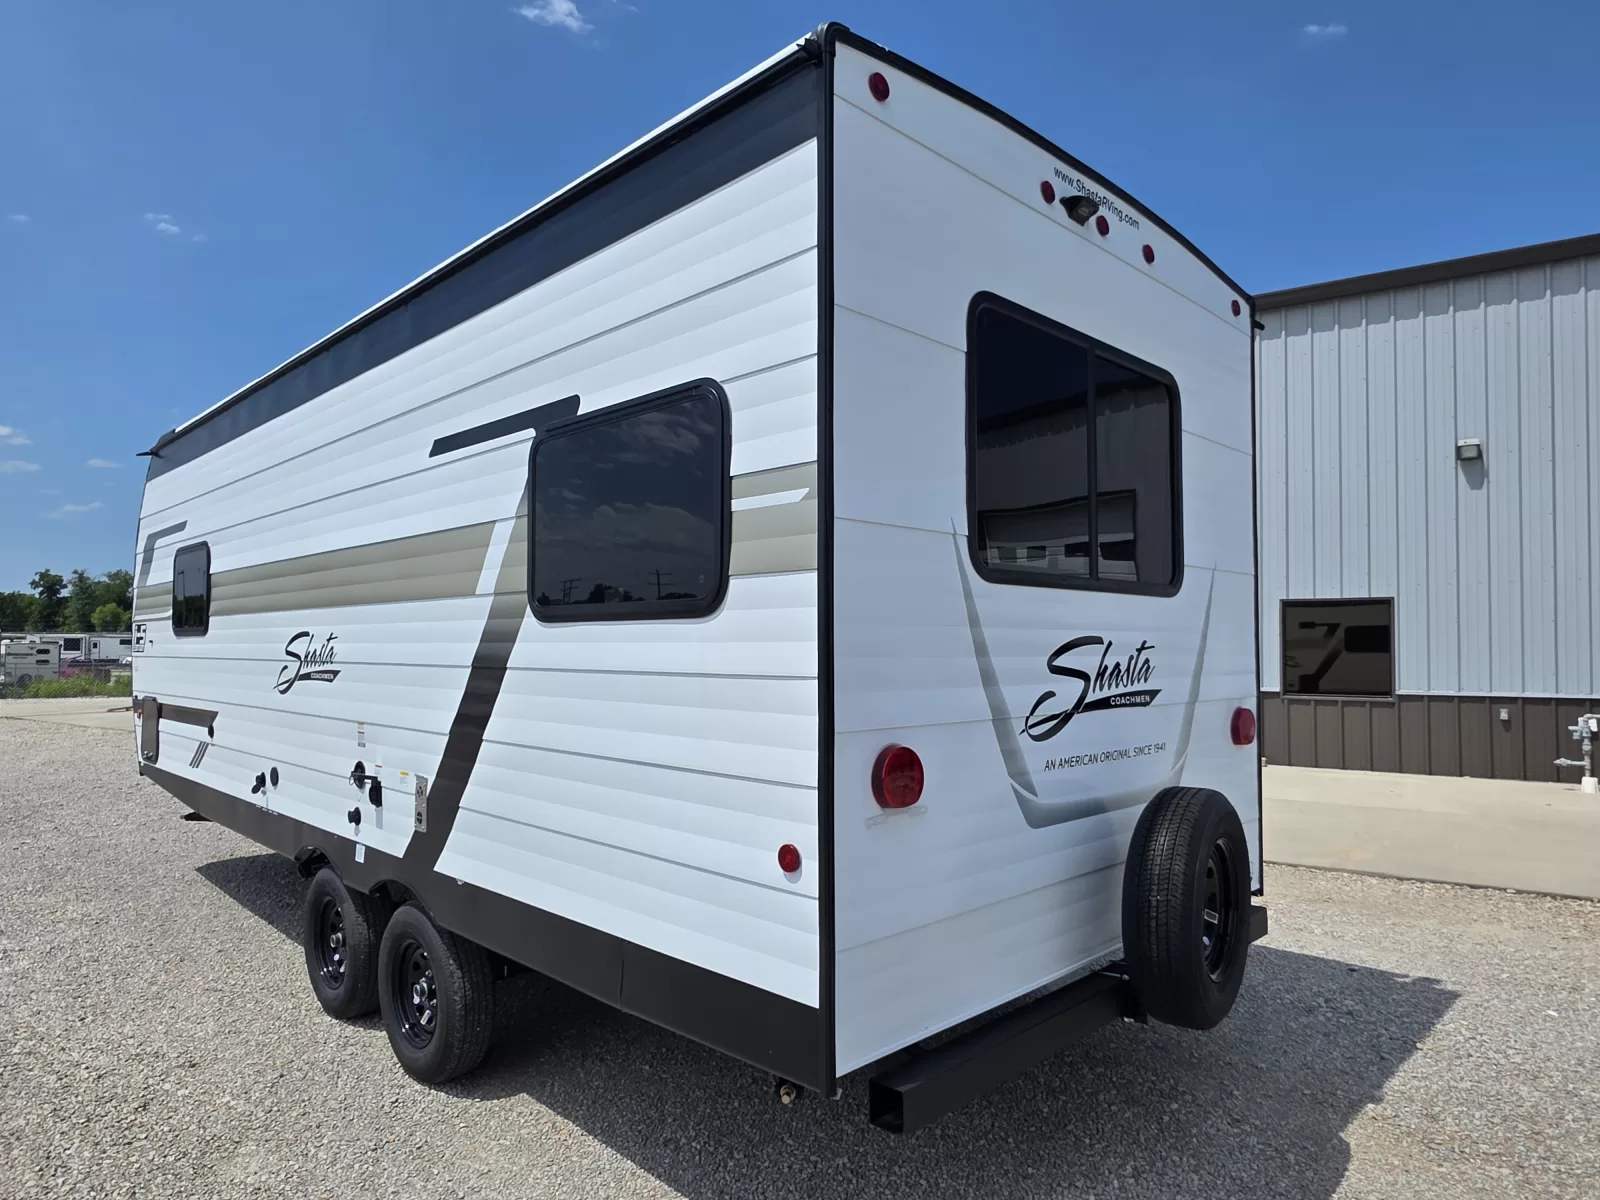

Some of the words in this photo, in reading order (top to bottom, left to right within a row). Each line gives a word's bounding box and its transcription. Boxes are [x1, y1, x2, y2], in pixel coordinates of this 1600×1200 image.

[1054, 167, 1140, 230] www.ShastaRVing.com
[276, 631, 338, 695] Shasta
[1024, 635, 1155, 742] Shasta
[1110, 695, 1150, 705] COACHMEN
[1043, 760, 1057, 772] AN
[1057, 753, 1099, 769] AMERICAN
[1099, 749, 1132, 763] ORIGINAL
[1132, 744, 1152, 757] SINCE
[1153, 742, 1167, 753] 1941
